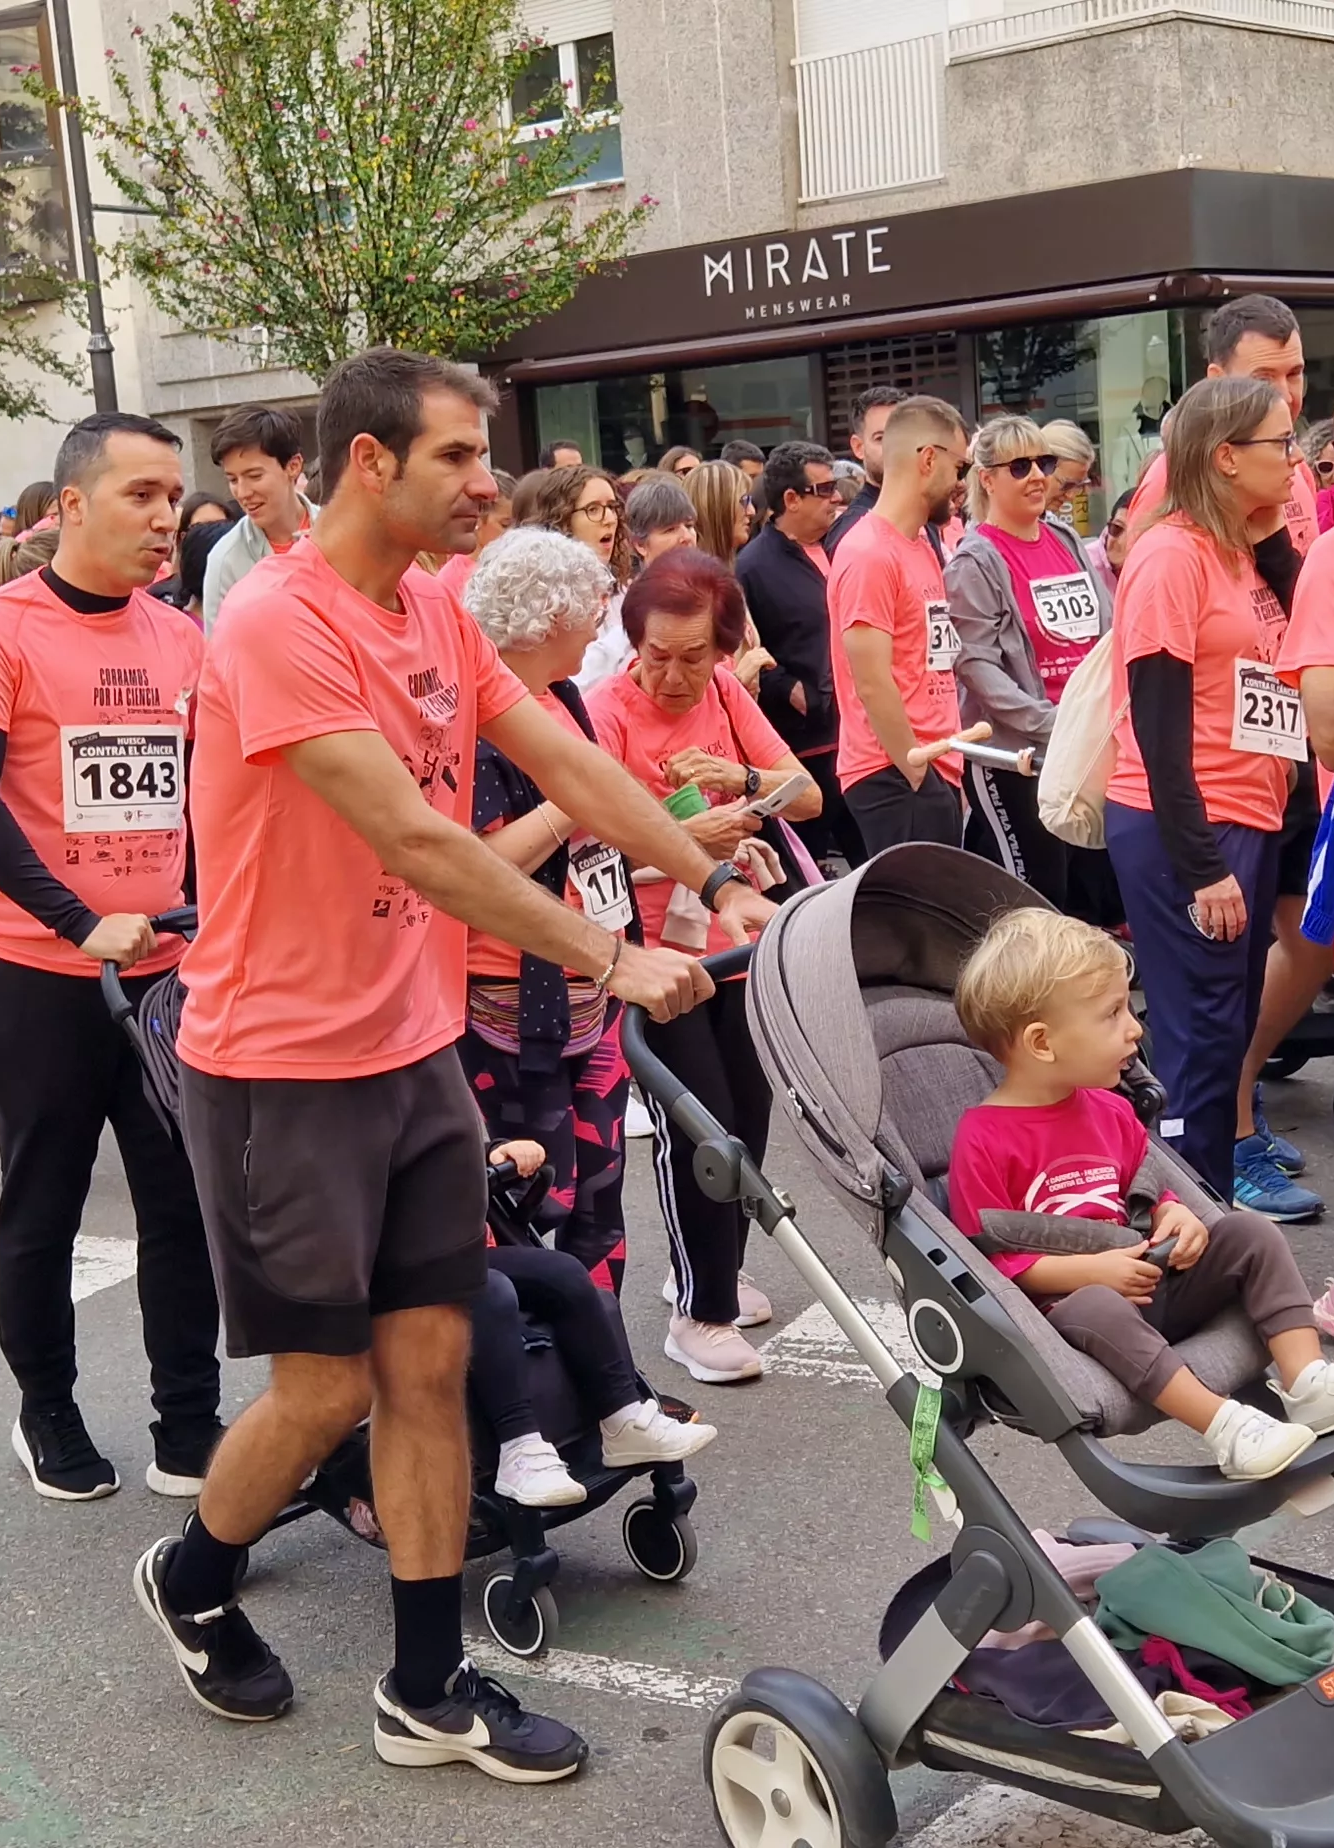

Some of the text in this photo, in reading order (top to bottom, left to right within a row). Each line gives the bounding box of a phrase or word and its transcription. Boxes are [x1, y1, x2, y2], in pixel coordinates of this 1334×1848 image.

[703, 226, 891, 297] MIRATE
[745, 293, 851, 320] MENSWEAR
[1041, 594, 1095, 622] 3103
[99, 668, 149, 686] CORRAMOS
[1244, 677, 1270, 690] CONTRA
[93, 687, 160, 706] POR LA CIENCIA
[1243, 692, 1299, 733] 2317
[79, 743, 174, 757] CONTRA EL CÁNCER
[117, 737, 146, 745] HUESCA
[79, 761, 176, 800] 1843
[997, 808, 1011, 831] FILA
[578, 851, 609, 870] CONTRA
